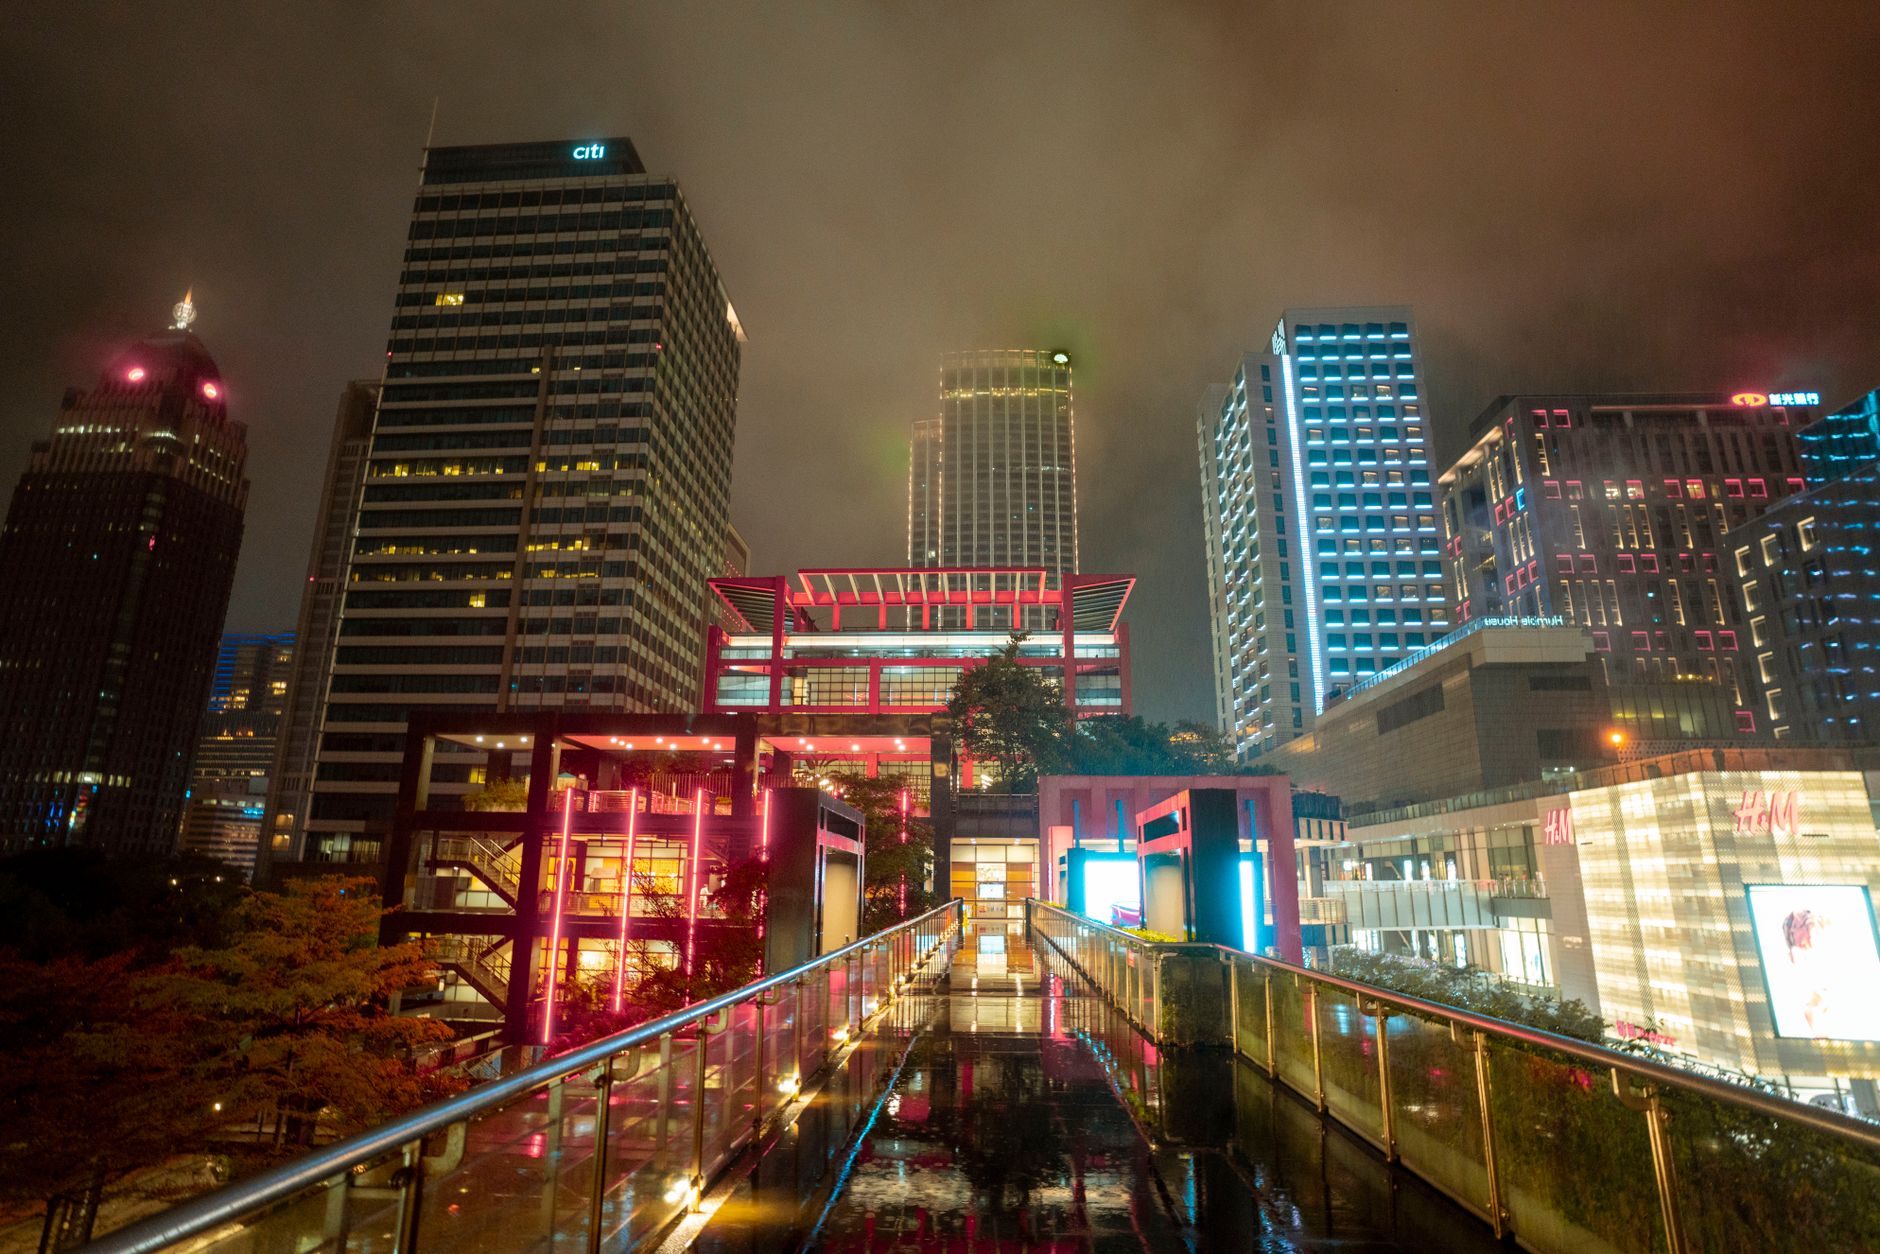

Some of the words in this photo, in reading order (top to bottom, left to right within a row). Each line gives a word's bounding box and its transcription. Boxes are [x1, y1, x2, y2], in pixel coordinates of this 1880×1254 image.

[573, 144, 604, 159] citi
[1544, 809, 1574, 845] H&M
[1734, 790, 1797, 835] H&M
